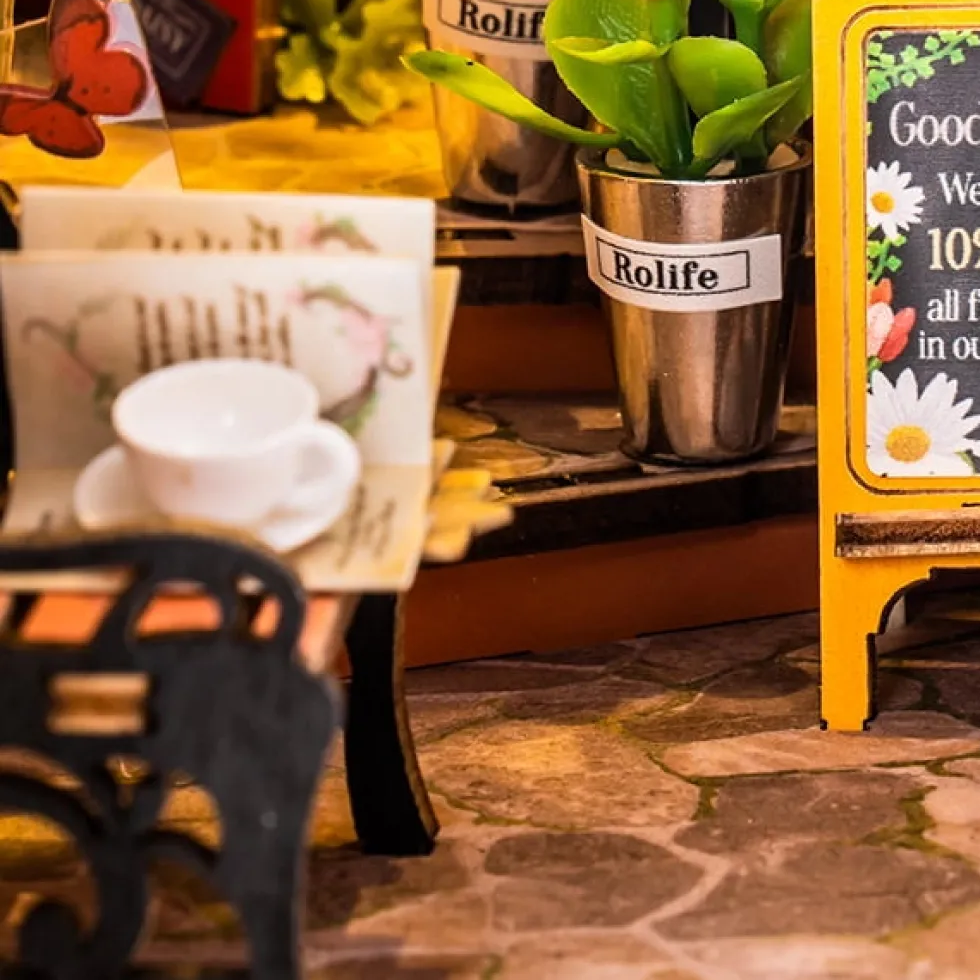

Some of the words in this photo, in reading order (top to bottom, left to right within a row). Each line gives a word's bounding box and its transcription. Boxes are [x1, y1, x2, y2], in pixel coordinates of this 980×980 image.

[613, 250, 720, 291] Rolife
[926, 288, 960, 322] all
[918, 330, 947, 361] in
